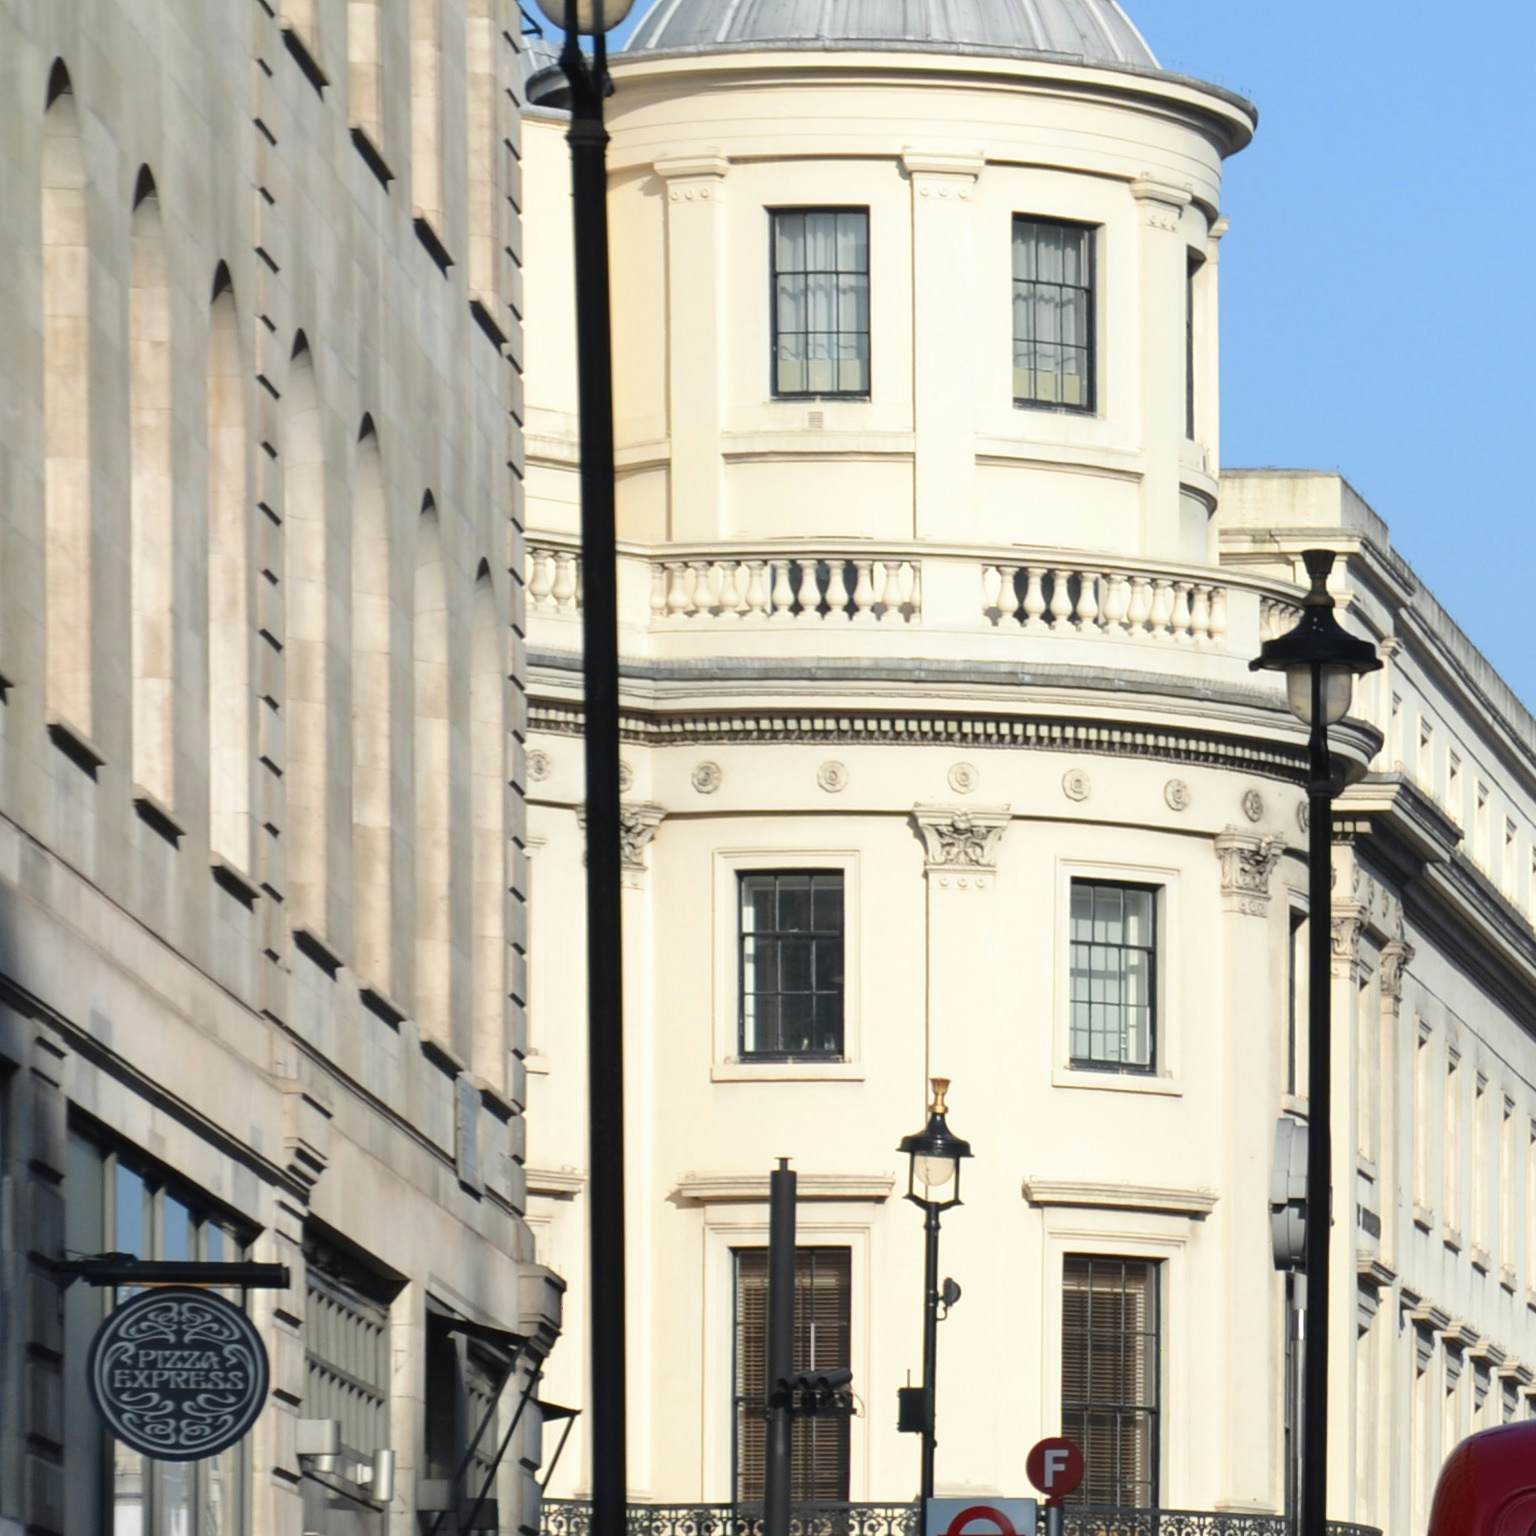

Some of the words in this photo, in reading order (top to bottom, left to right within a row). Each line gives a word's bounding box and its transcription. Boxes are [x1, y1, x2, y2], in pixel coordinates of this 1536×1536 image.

[137, 1349, 220, 1369] PIZZA
[113, 1369, 245, 1390] EXPRESS
[1044, 1449, 1069, 1488] F
